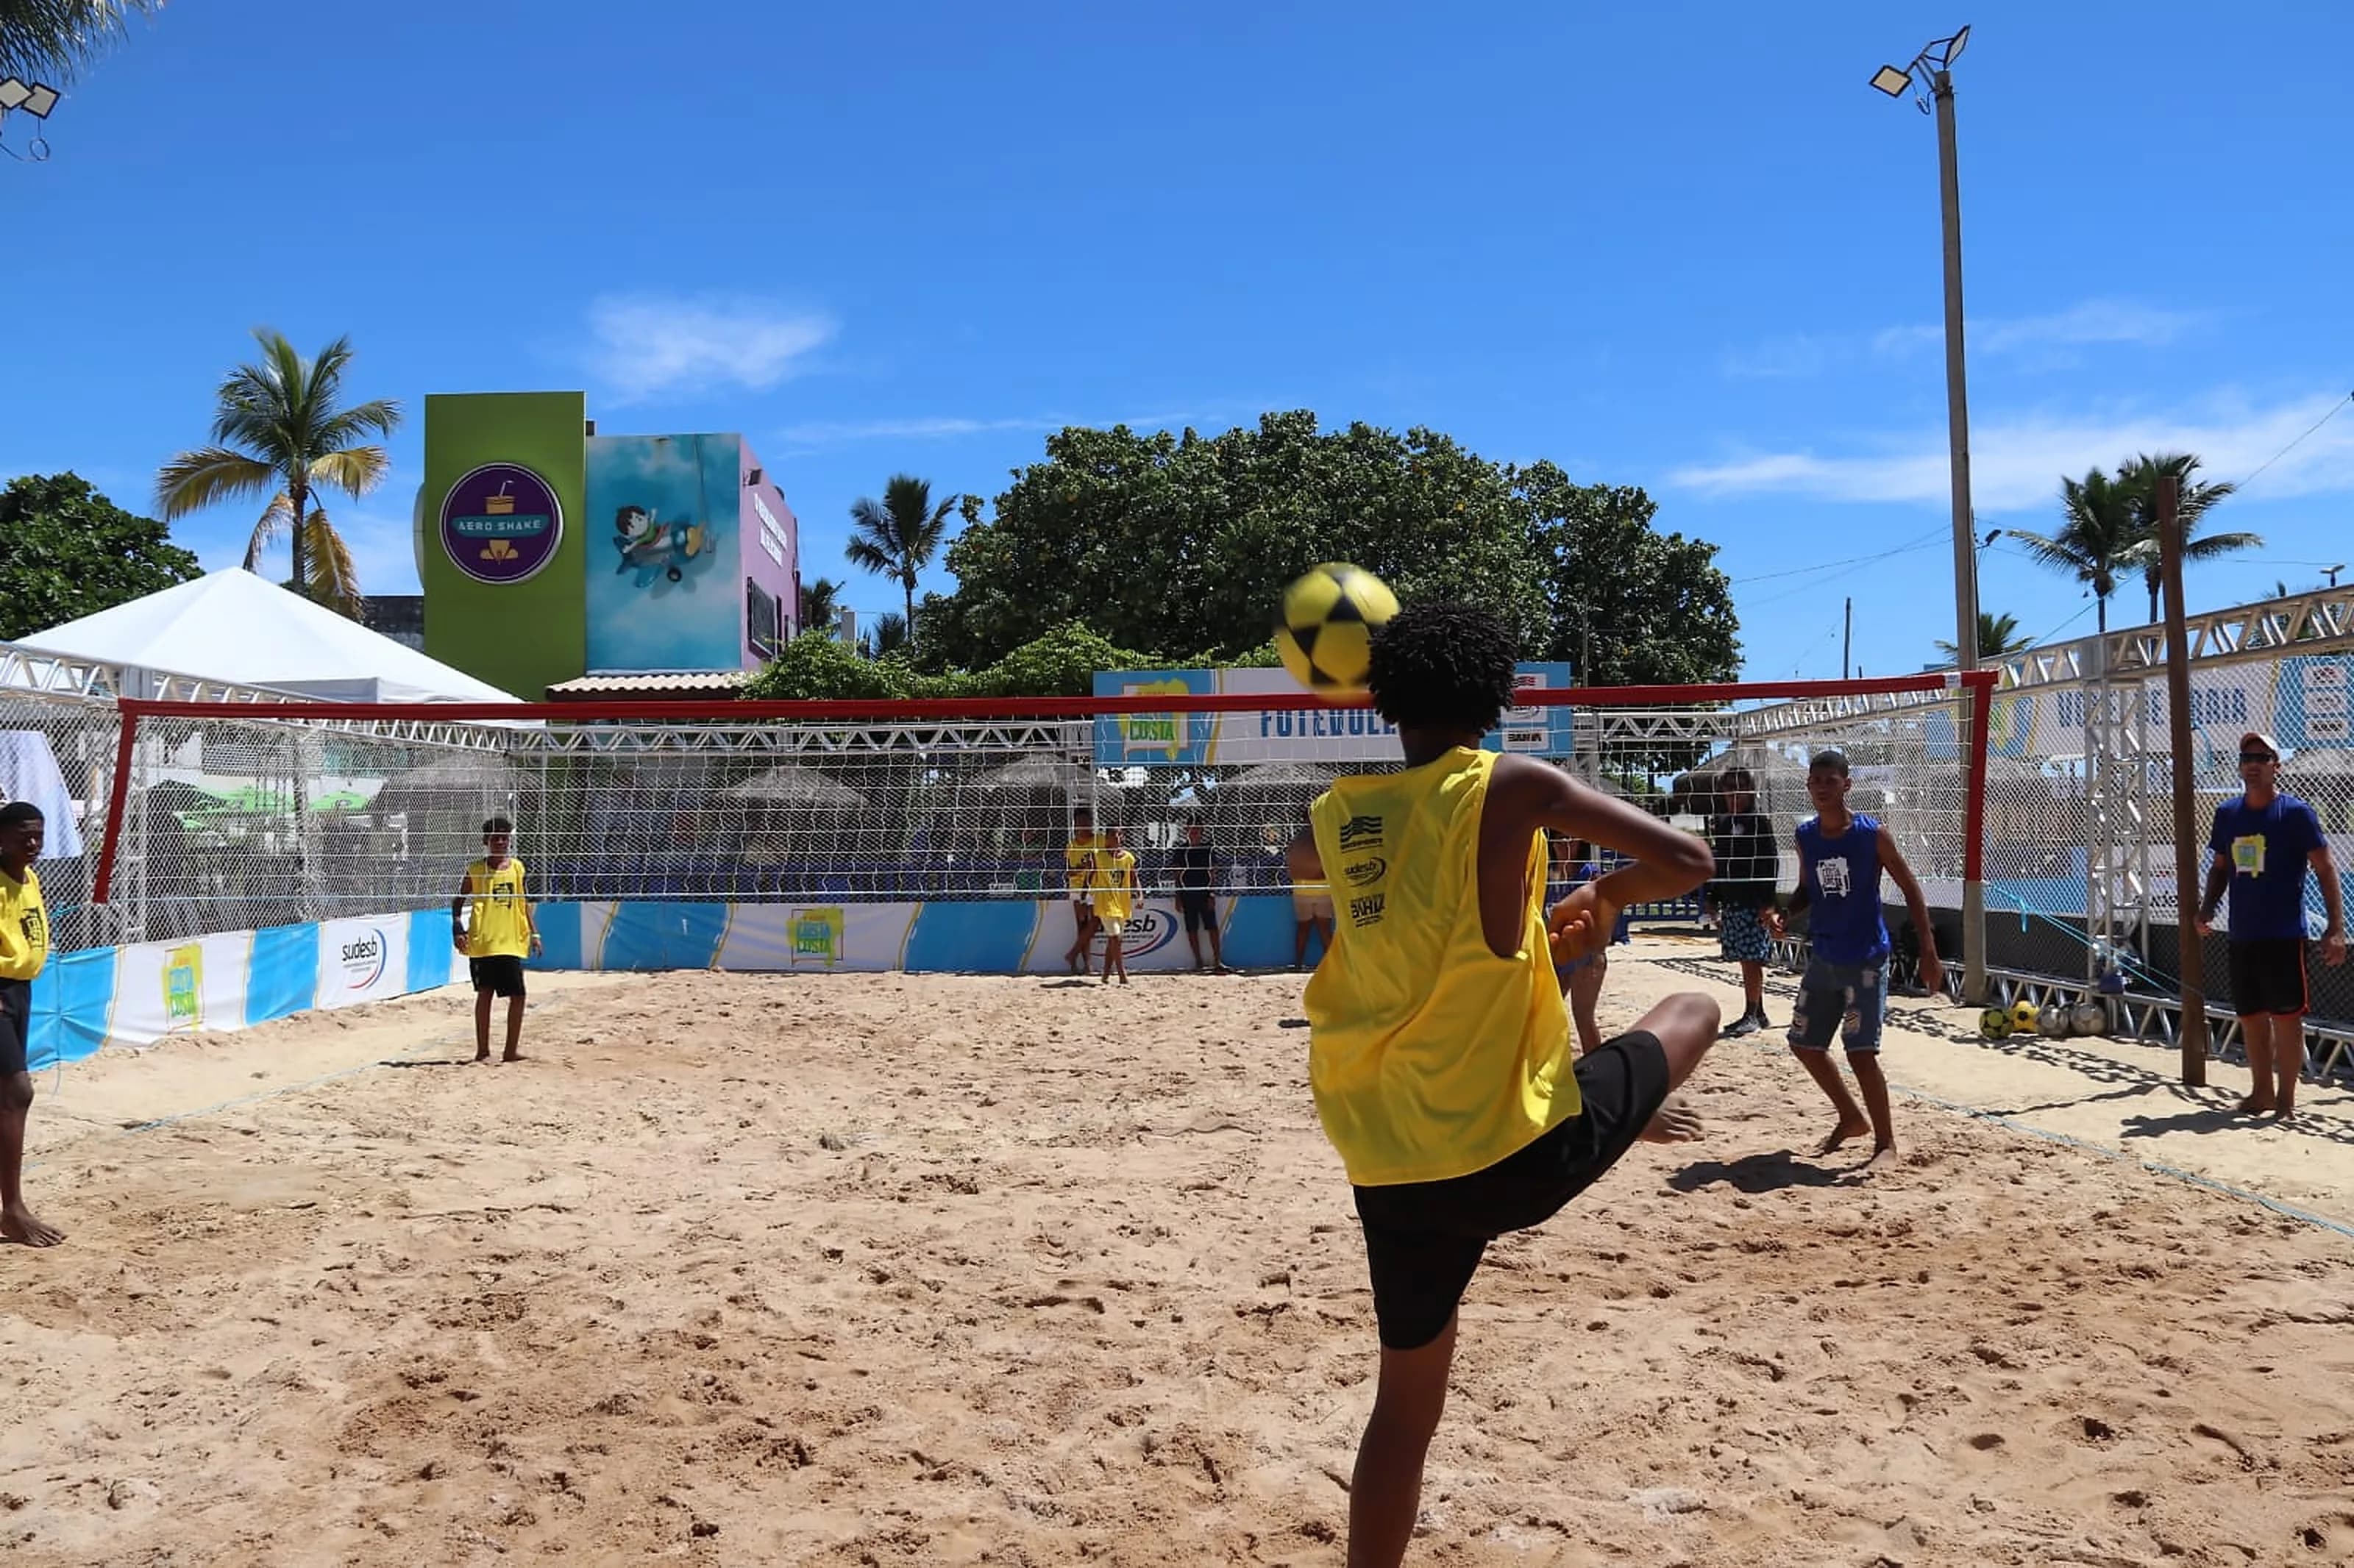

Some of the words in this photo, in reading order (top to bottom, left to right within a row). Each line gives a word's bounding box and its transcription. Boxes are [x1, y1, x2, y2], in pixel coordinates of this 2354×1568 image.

[458, 521, 492, 530] AERO
[497, 519, 542, 530] SHAKE
[342, 936, 377, 961] sudesb
